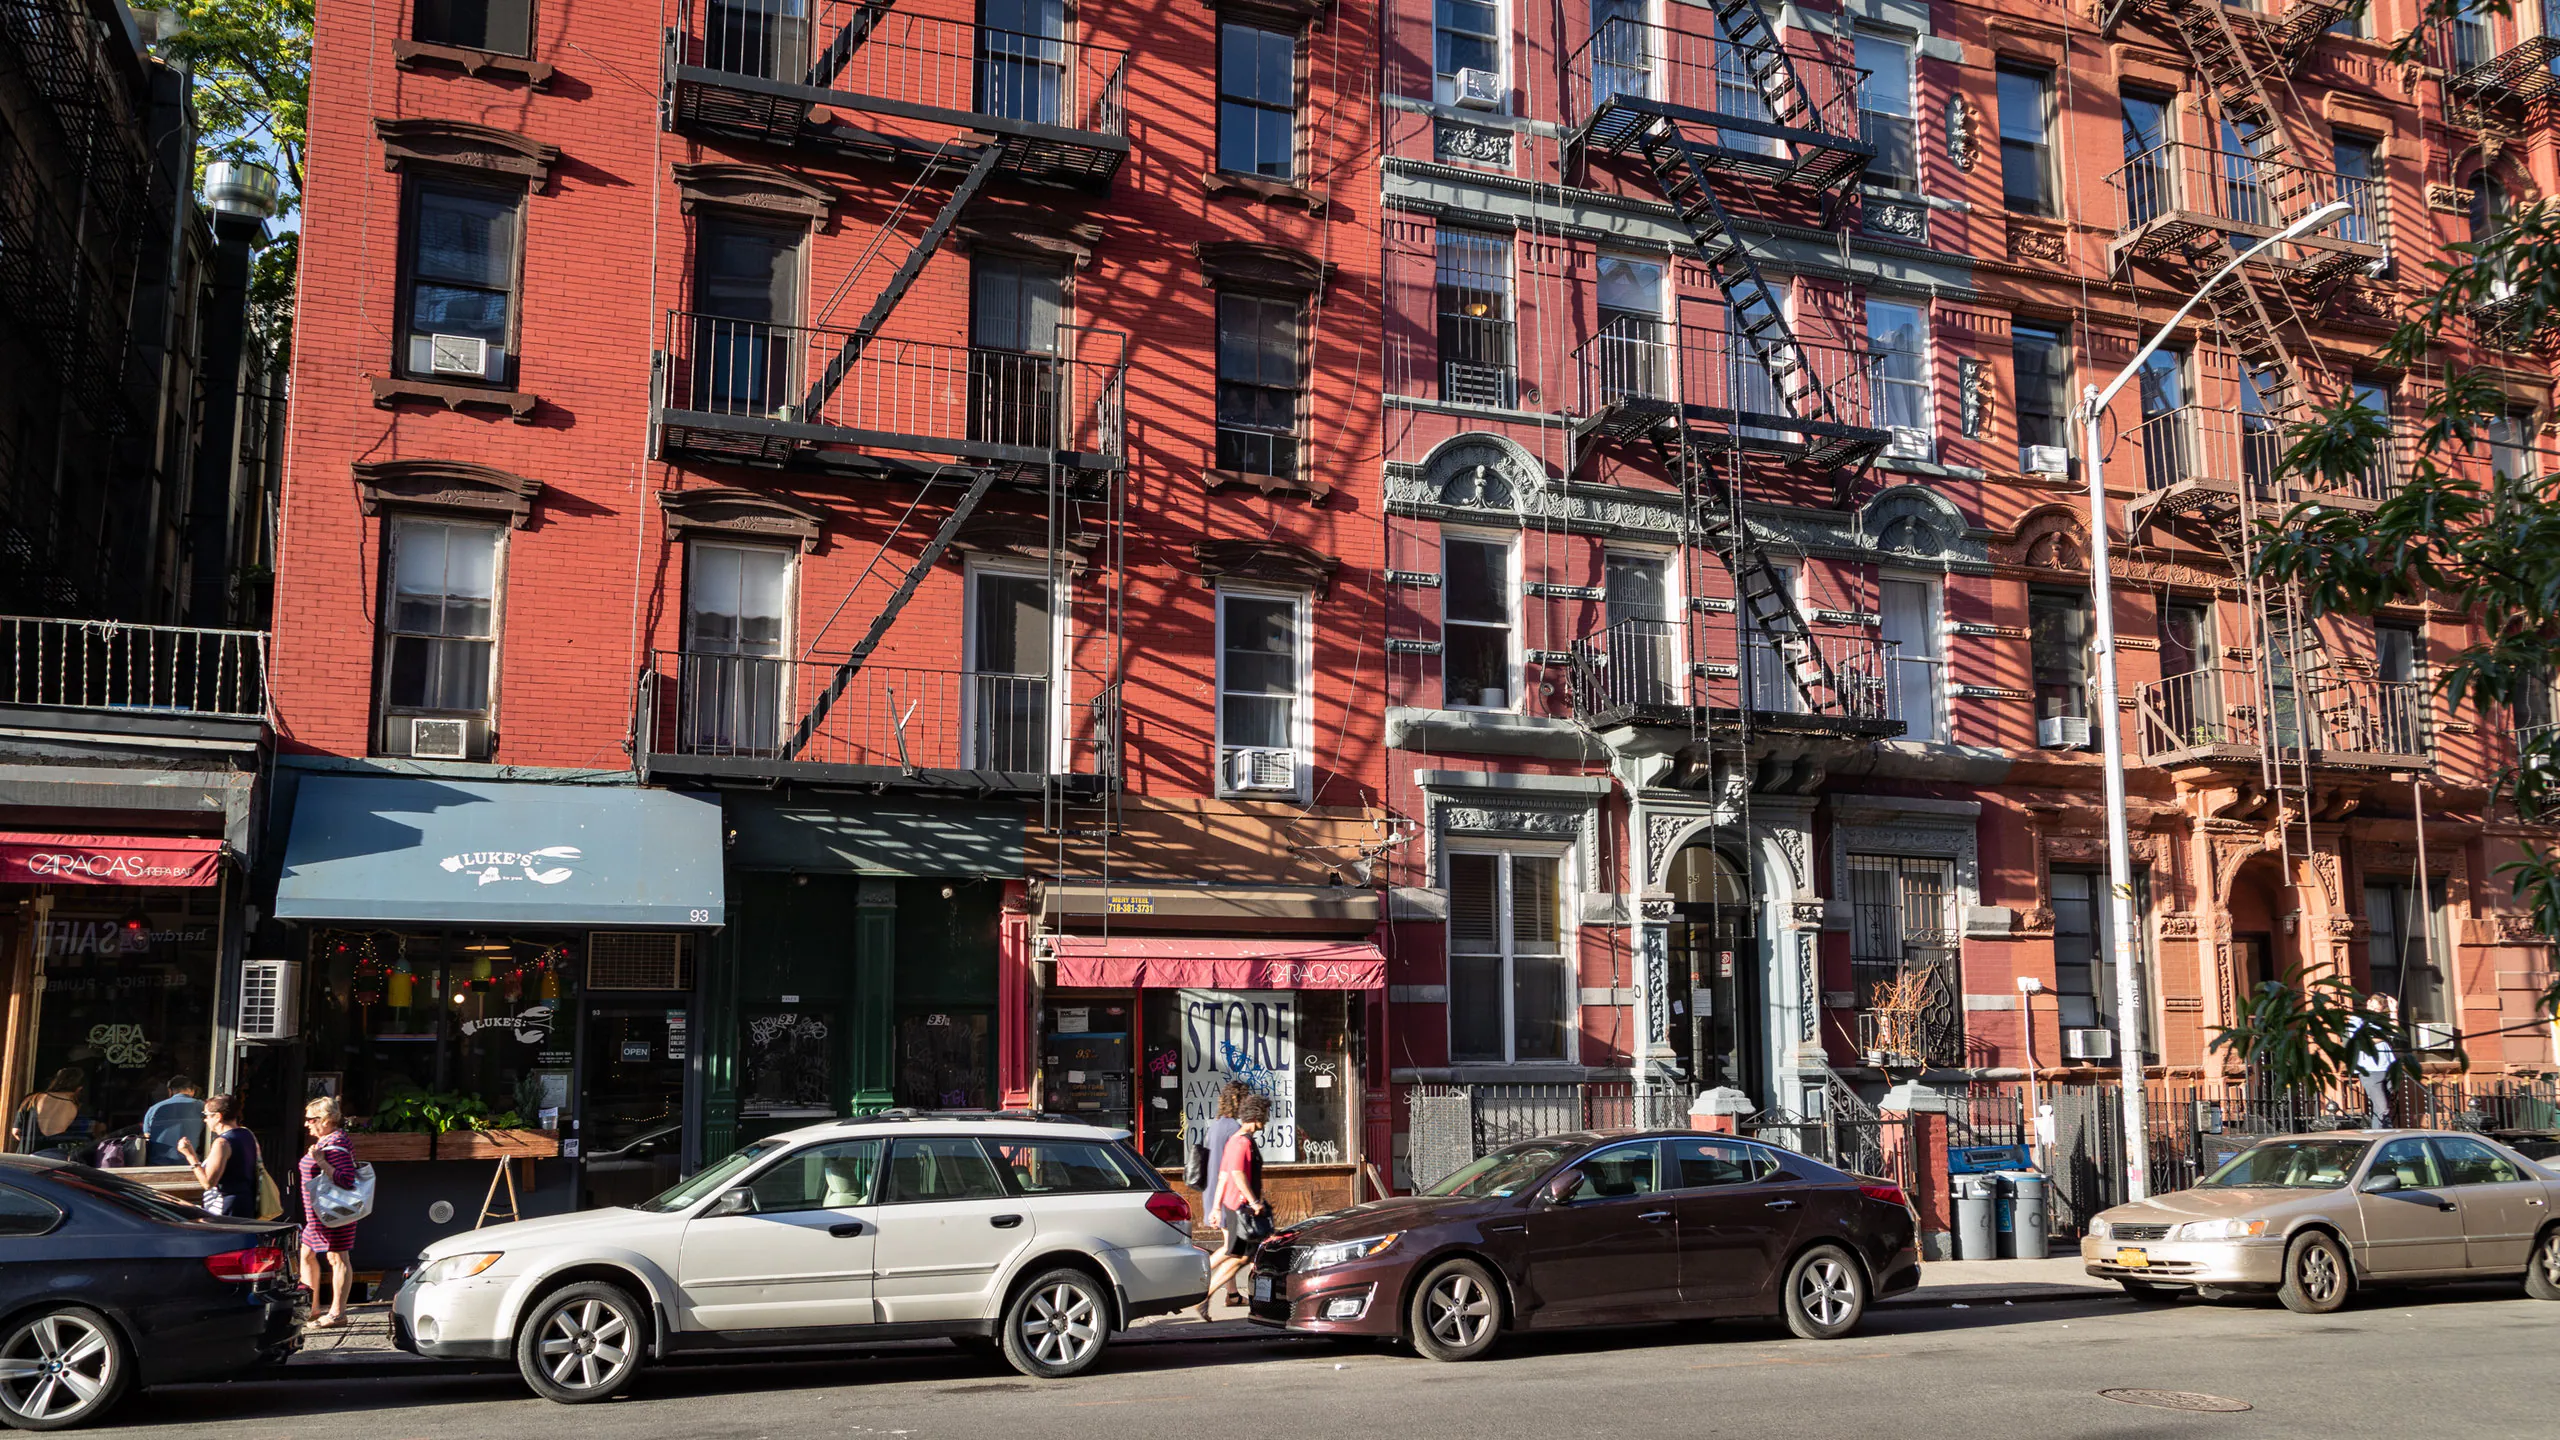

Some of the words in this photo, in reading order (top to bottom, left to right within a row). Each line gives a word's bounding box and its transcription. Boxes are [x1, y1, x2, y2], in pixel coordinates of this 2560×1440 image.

[28, 853, 143, 877] CARACAS
[143, 866, 172, 876] AREPA
[173, 867, 196, 877] BAR
[462, 852, 533, 867] LUKE'S
[1688, 874, 1699, 884] 95
[1107, 904, 1153, 913] 718-381-3731
[690, 909, 709, 923] 93
[1266, 963, 1350, 983] CARACAS
[475, 1017, 521, 1029] LUKE'S
[781, 1014, 795, 1024] 93
[929, 1015, 944, 1025] 93
[1187, 1002, 1290, 1073] STORE
[623, 1048, 648, 1057] OPEN
[1186, 1101, 1214, 1120] CAL
